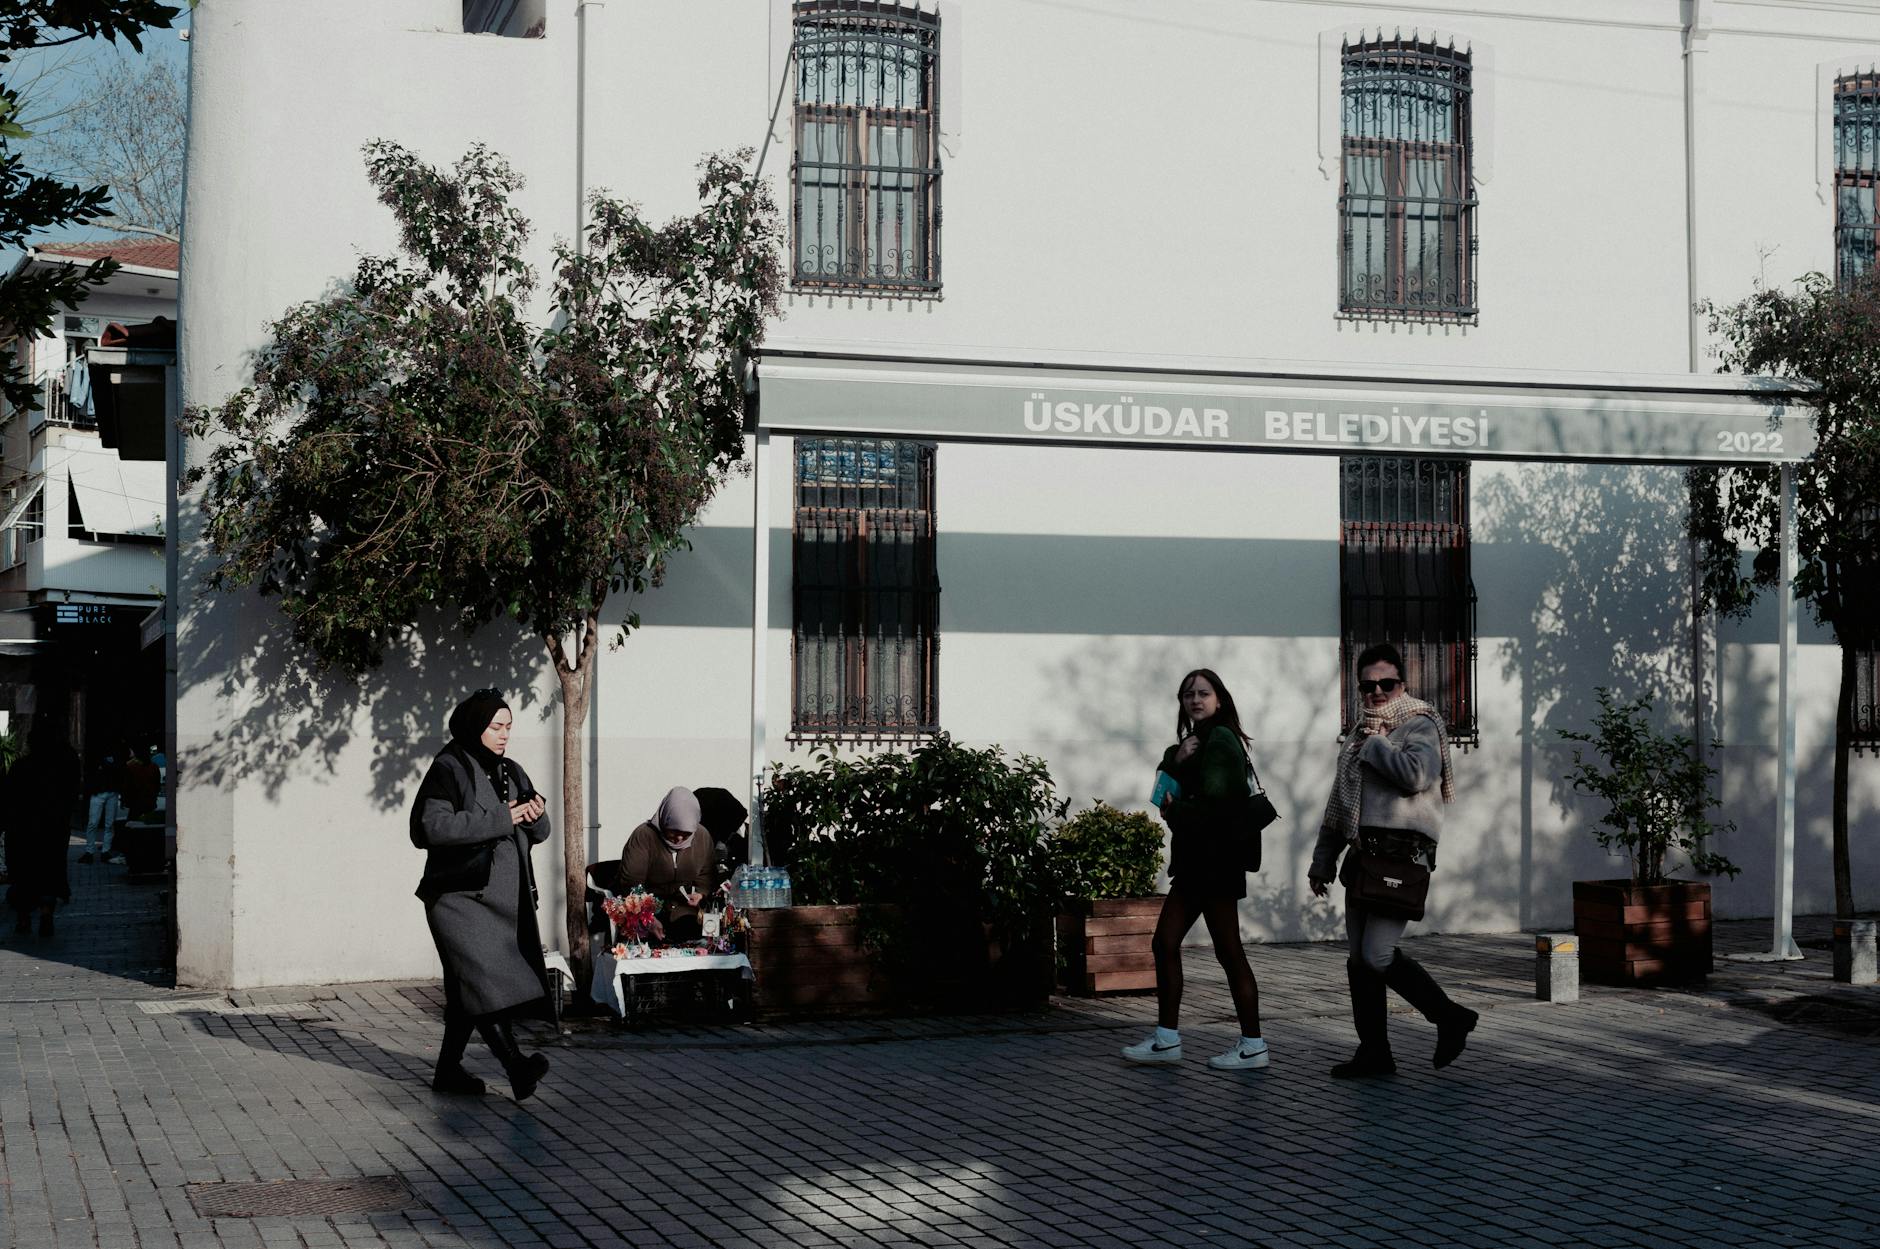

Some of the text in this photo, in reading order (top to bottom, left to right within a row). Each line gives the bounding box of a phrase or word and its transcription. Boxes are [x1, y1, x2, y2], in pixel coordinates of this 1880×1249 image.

[1023, 393, 1489, 447] ÜSKÜDAR BELEDİYESİ
[1716, 430, 1785, 453] 2022
[79, 605, 106, 613] PURE
